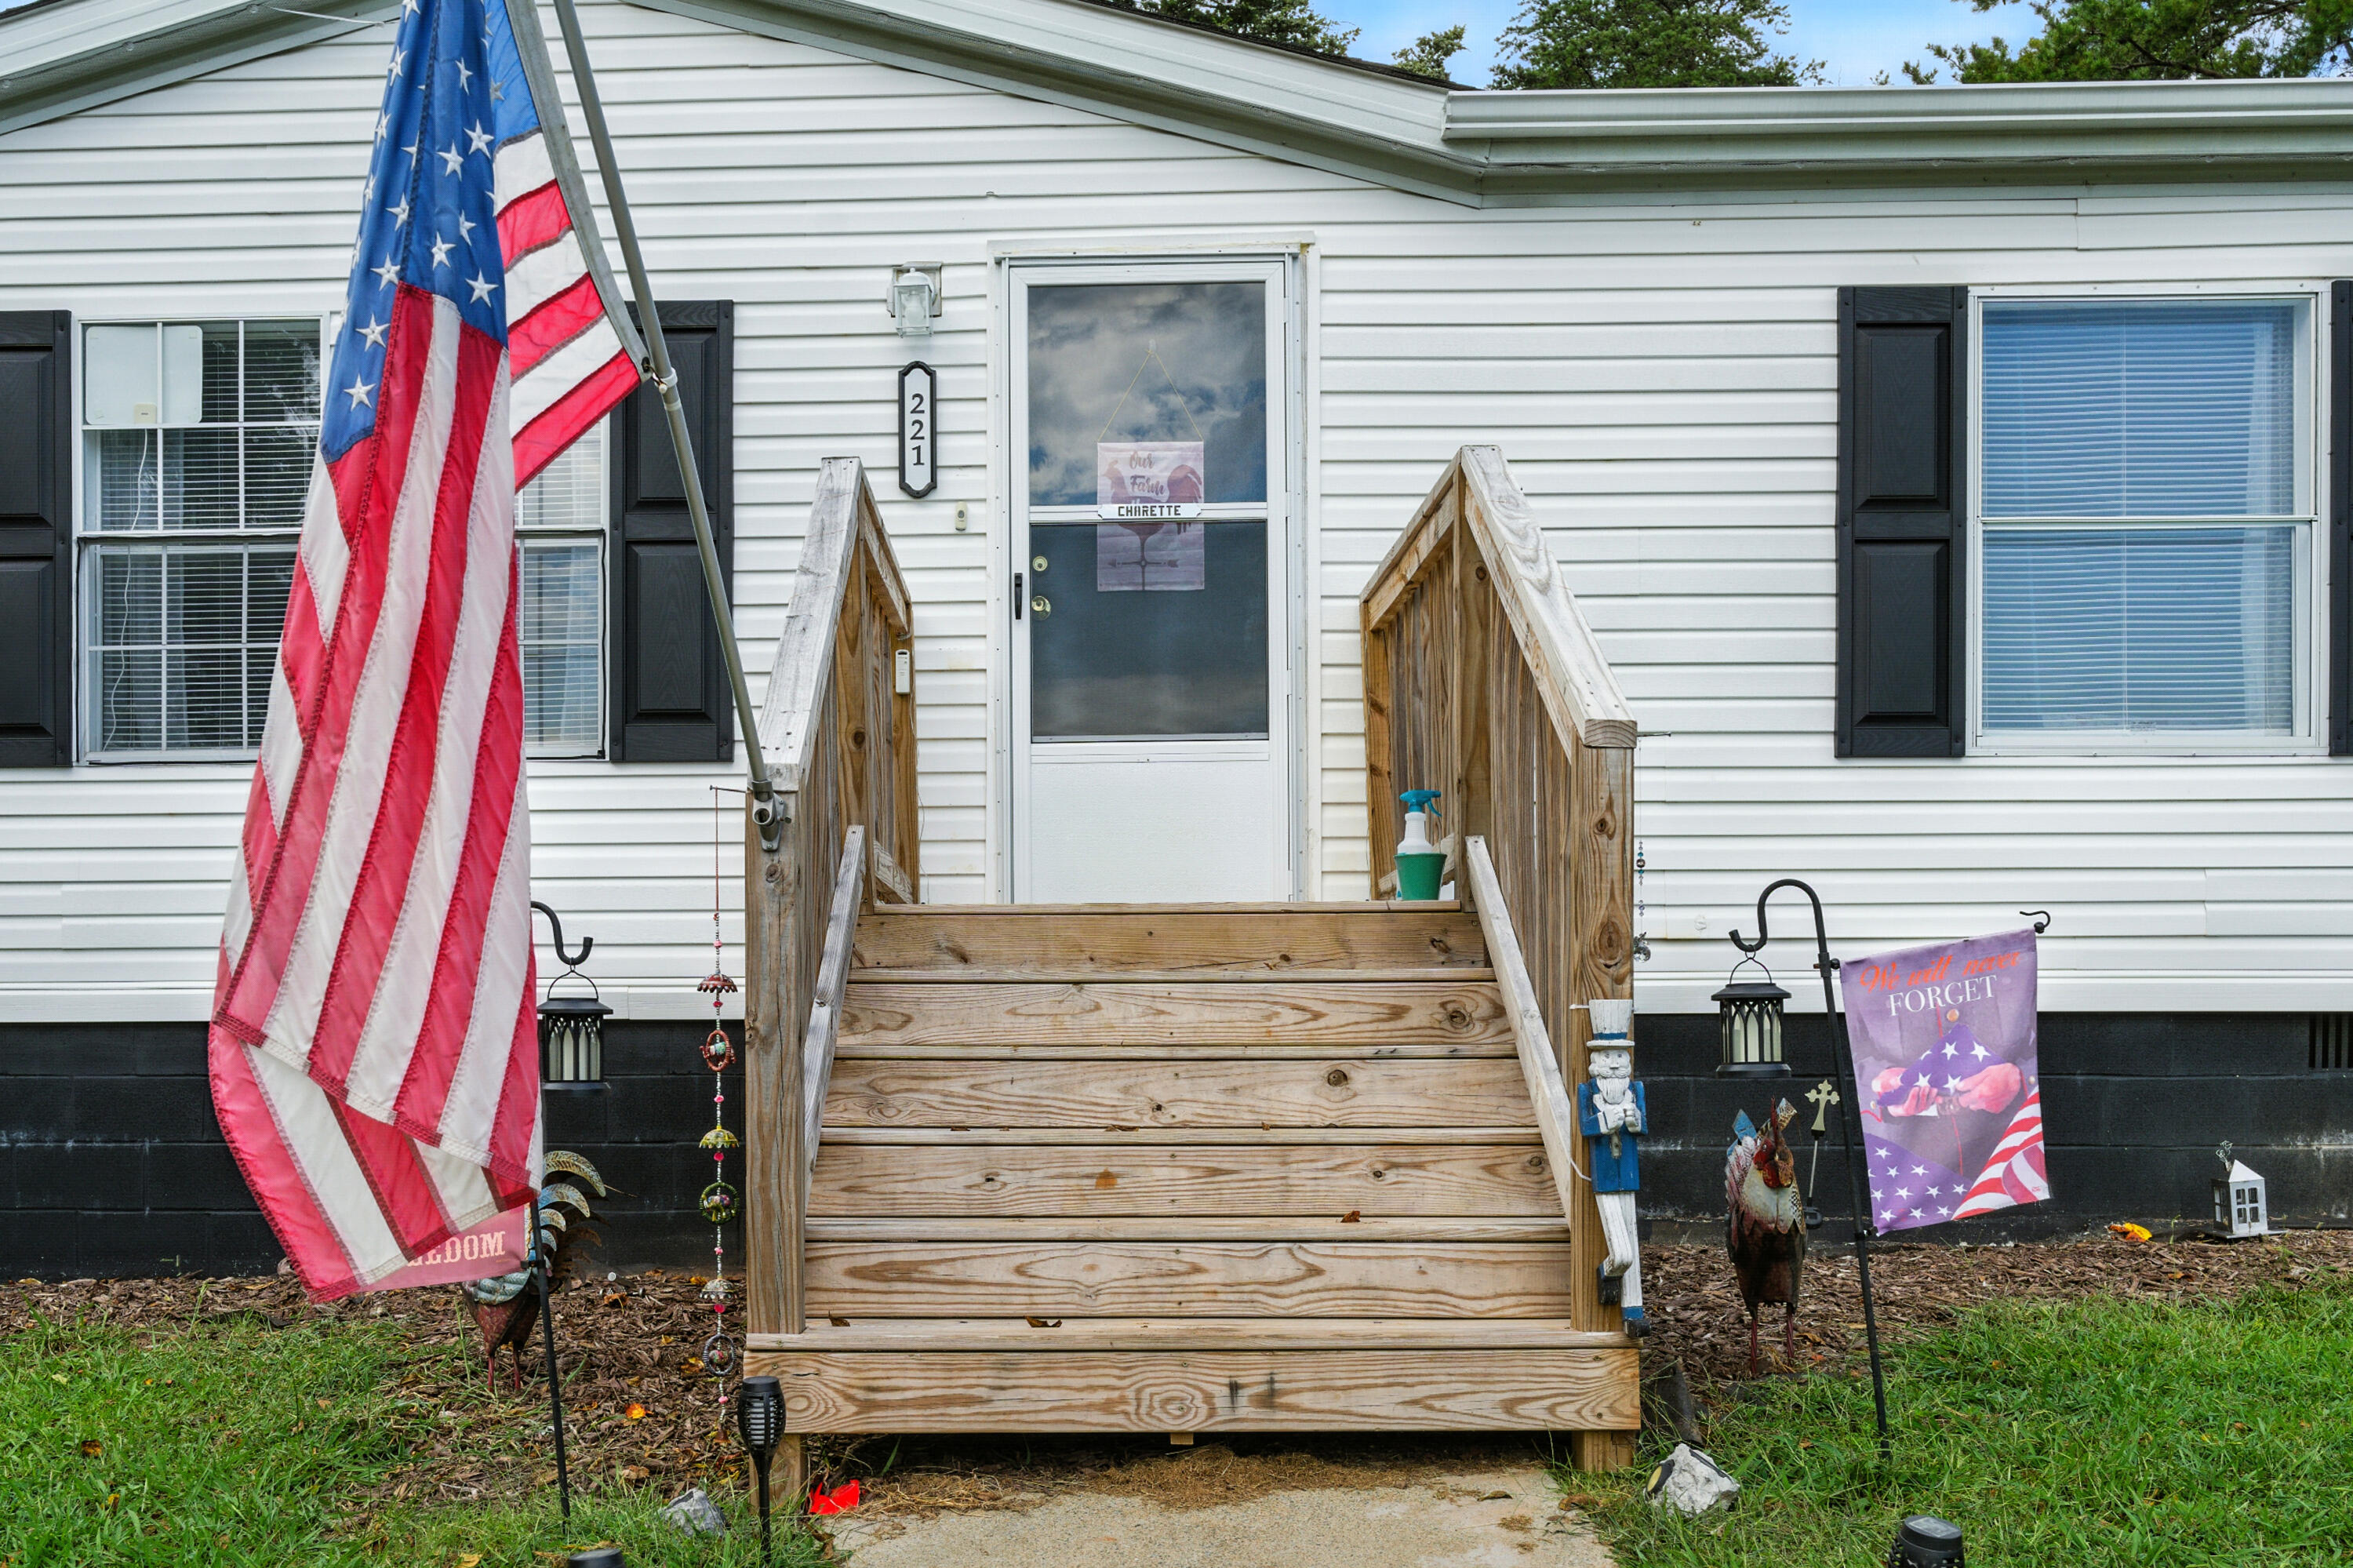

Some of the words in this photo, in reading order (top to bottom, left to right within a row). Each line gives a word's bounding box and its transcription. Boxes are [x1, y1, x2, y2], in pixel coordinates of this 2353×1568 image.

[910, 393, 926, 466] 221
[1129, 451, 1155, 470] Our
[1130, 475, 1166, 497] Farm
[1118, 505, 1181, 517] CHARETTE
[1860, 962, 1900, 994] We
[1907, 955, 1953, 987] will
[1962, 951, 2020, 976] never
[1888, 975, 1997, 1017] FORGET
